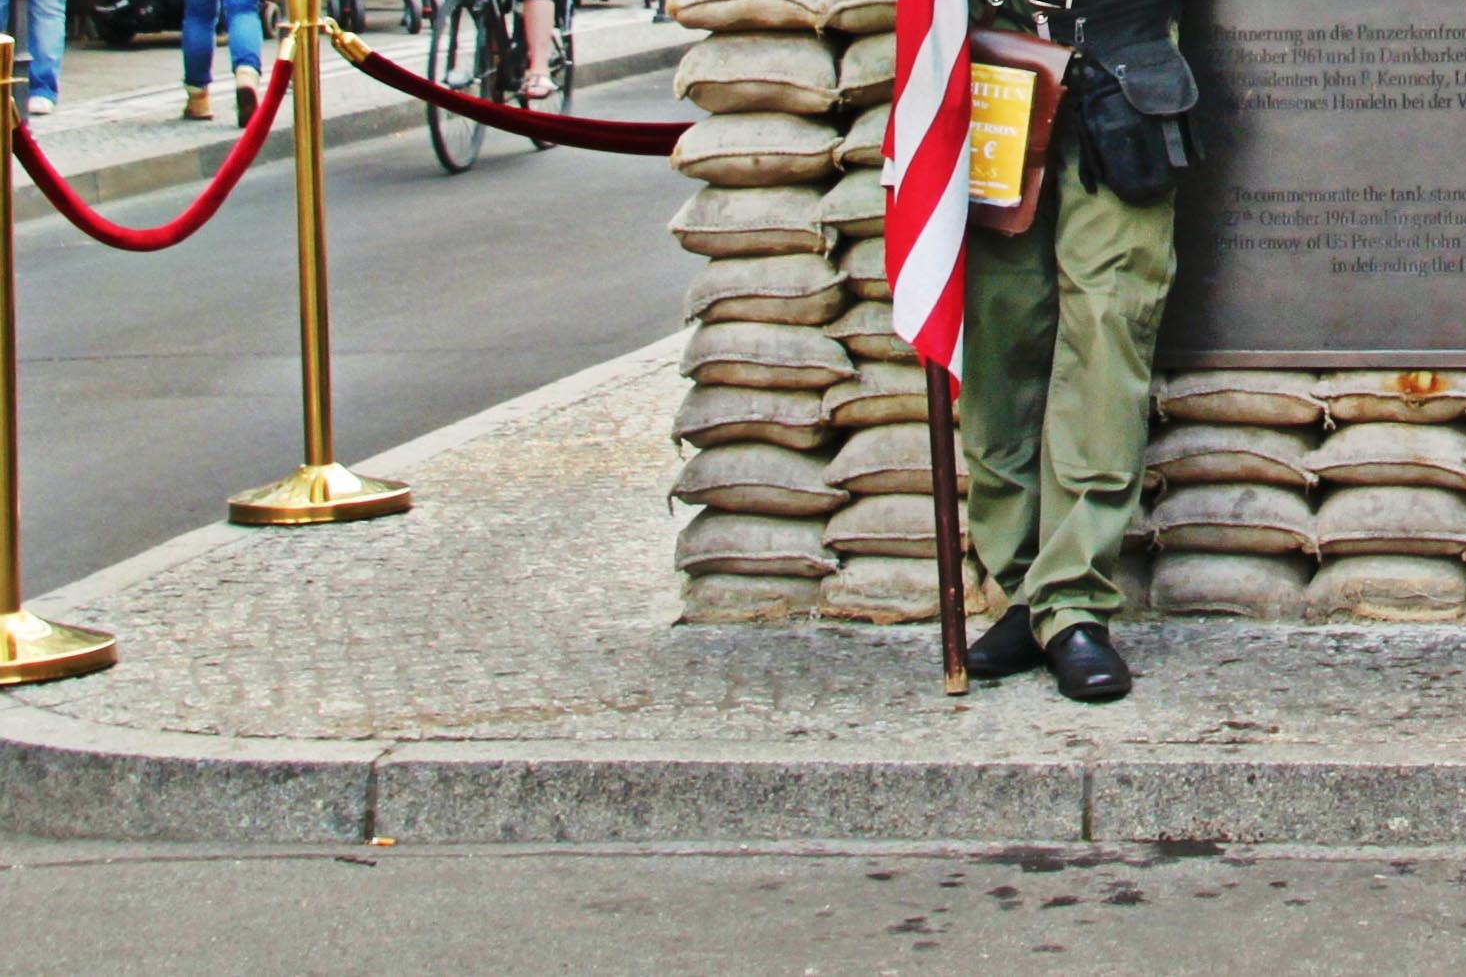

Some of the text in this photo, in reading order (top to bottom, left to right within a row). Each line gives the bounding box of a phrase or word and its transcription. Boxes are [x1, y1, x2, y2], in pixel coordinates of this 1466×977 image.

[1306, 28, 1326, 42] an
[1329, 24, 1353, 41] die
[1291, 46, 1322, 64] 1961
[1326, 46, 1355, 64] und
[1358, 47, 1376, 64] in
[1322, 70, 1357, 90] John
[1332, 93, 1397, 110] Handeln
[1401, 93, 1425, 110] bei
[1427, 93, 1453, 109] der
[1253, 186, 1360, 203] commemorate
[1362, 185, 1387, 203] the
[1390, 185, 1425, 203] tank
[1258, 209, 1320, 227] October
[1325, 209, 1356, 226] 1961
[1358, 209, 1389, 226] and
[1258, 236, 1300, 253] envoy
[1306, 233, 1322, 250] of
[1324, 233, 1347, 250] US
[1351, 232, 1420, 250] President
[1330, 256, 1347, 272] in
[1350, 256, 1429, 277] defending
[1431, 256, 1457, 273] the
